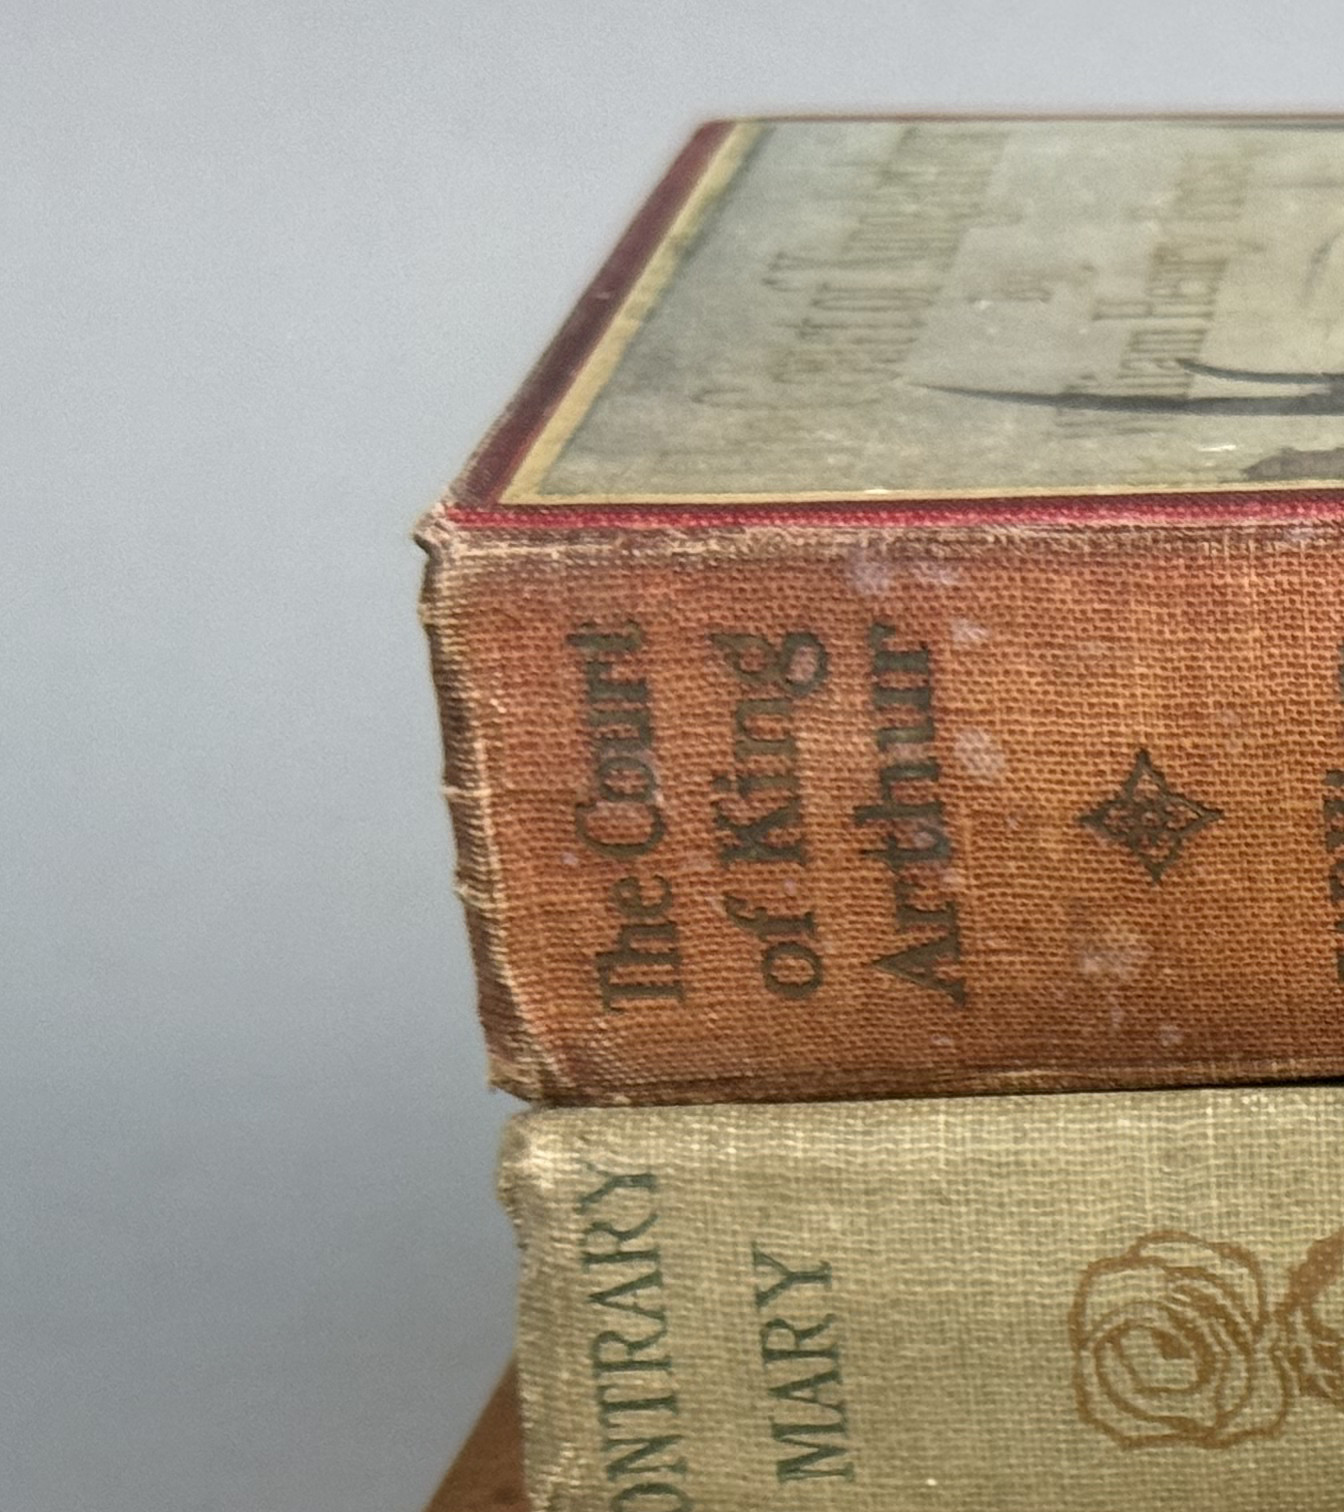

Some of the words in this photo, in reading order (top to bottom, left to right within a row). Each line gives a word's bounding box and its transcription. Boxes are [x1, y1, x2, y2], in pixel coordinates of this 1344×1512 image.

[566, 619, 667, 858] Court
[708, 631, 829, 866] King
[853, 622, 968, 1008] Arthur
[596, 875, 683, 1013] The
[724, 895, 824, 999] of
[753, 1242, 856, 1486] MARY
